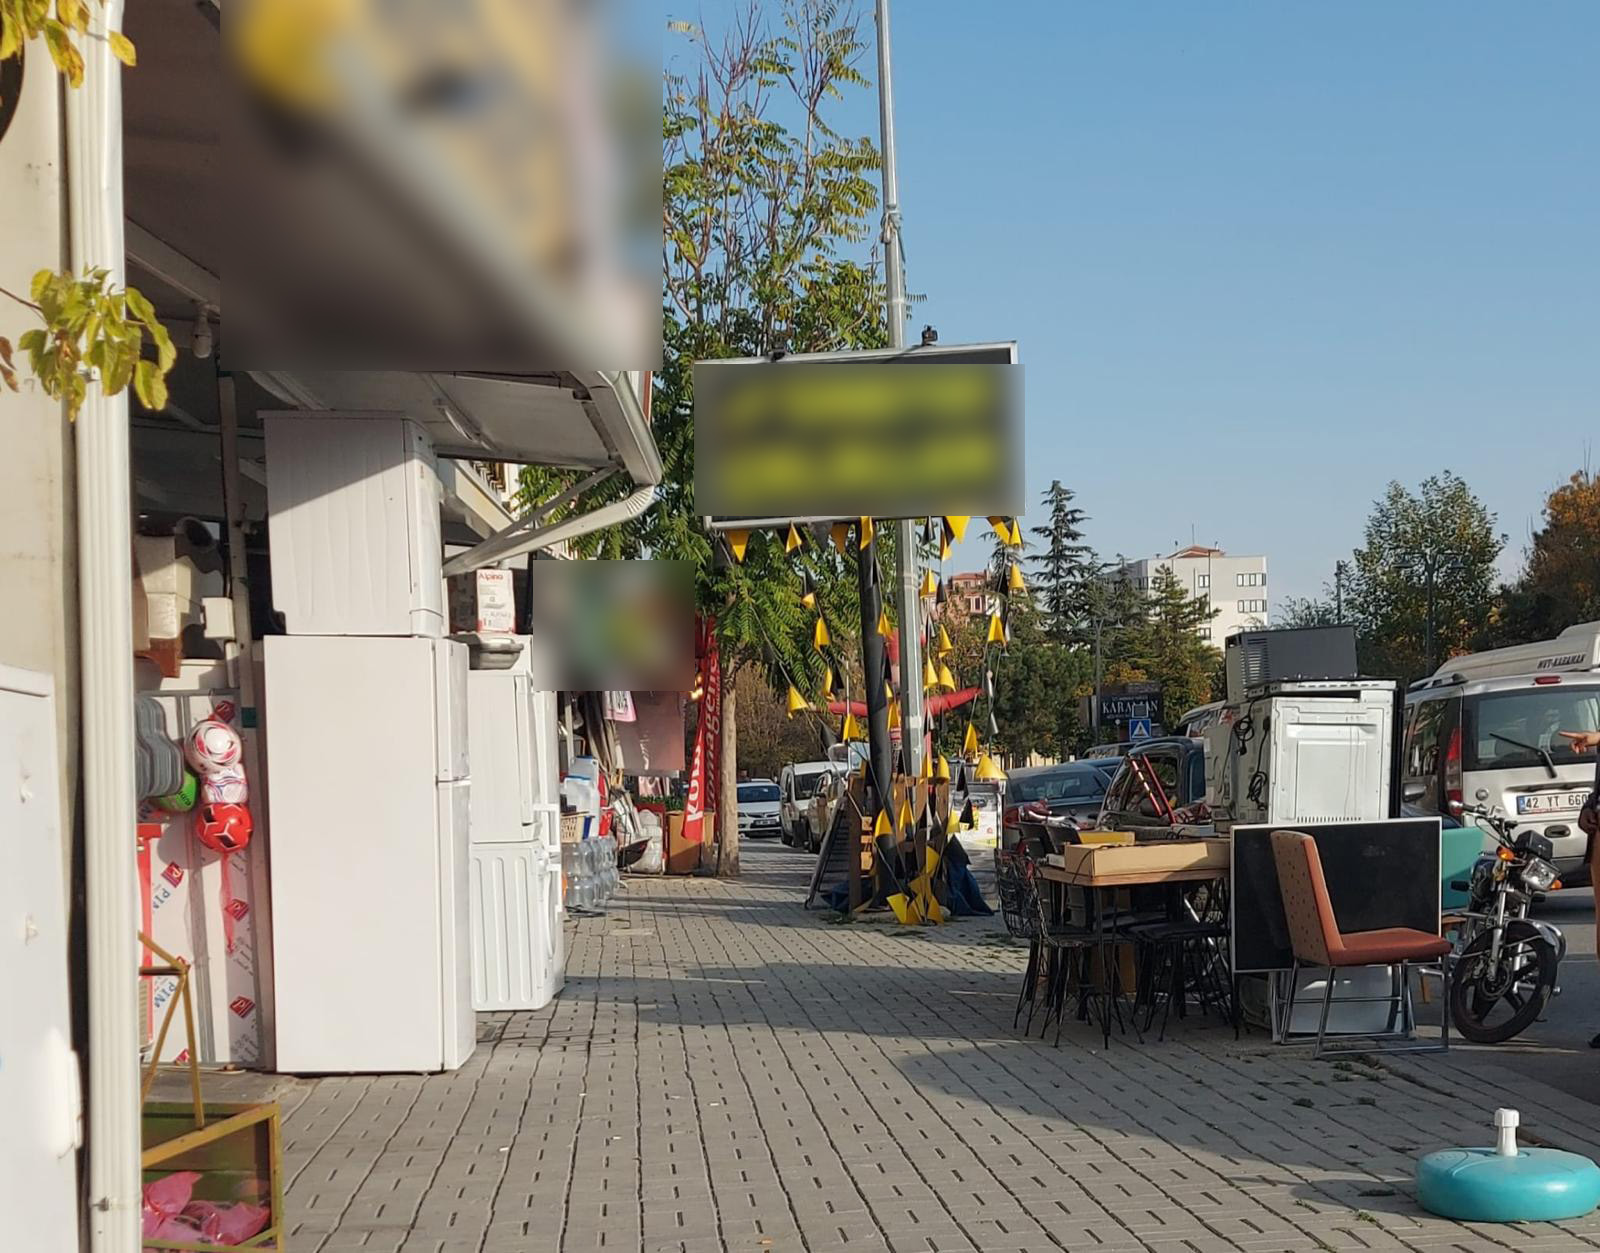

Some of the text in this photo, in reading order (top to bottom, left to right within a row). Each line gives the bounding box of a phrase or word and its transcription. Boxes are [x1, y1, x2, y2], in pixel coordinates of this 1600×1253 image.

[1102, 700, 1159, 714] KARAAN
[1525, 797, 1540, 808] 42
[1547, 795, 1560, 807] YT
